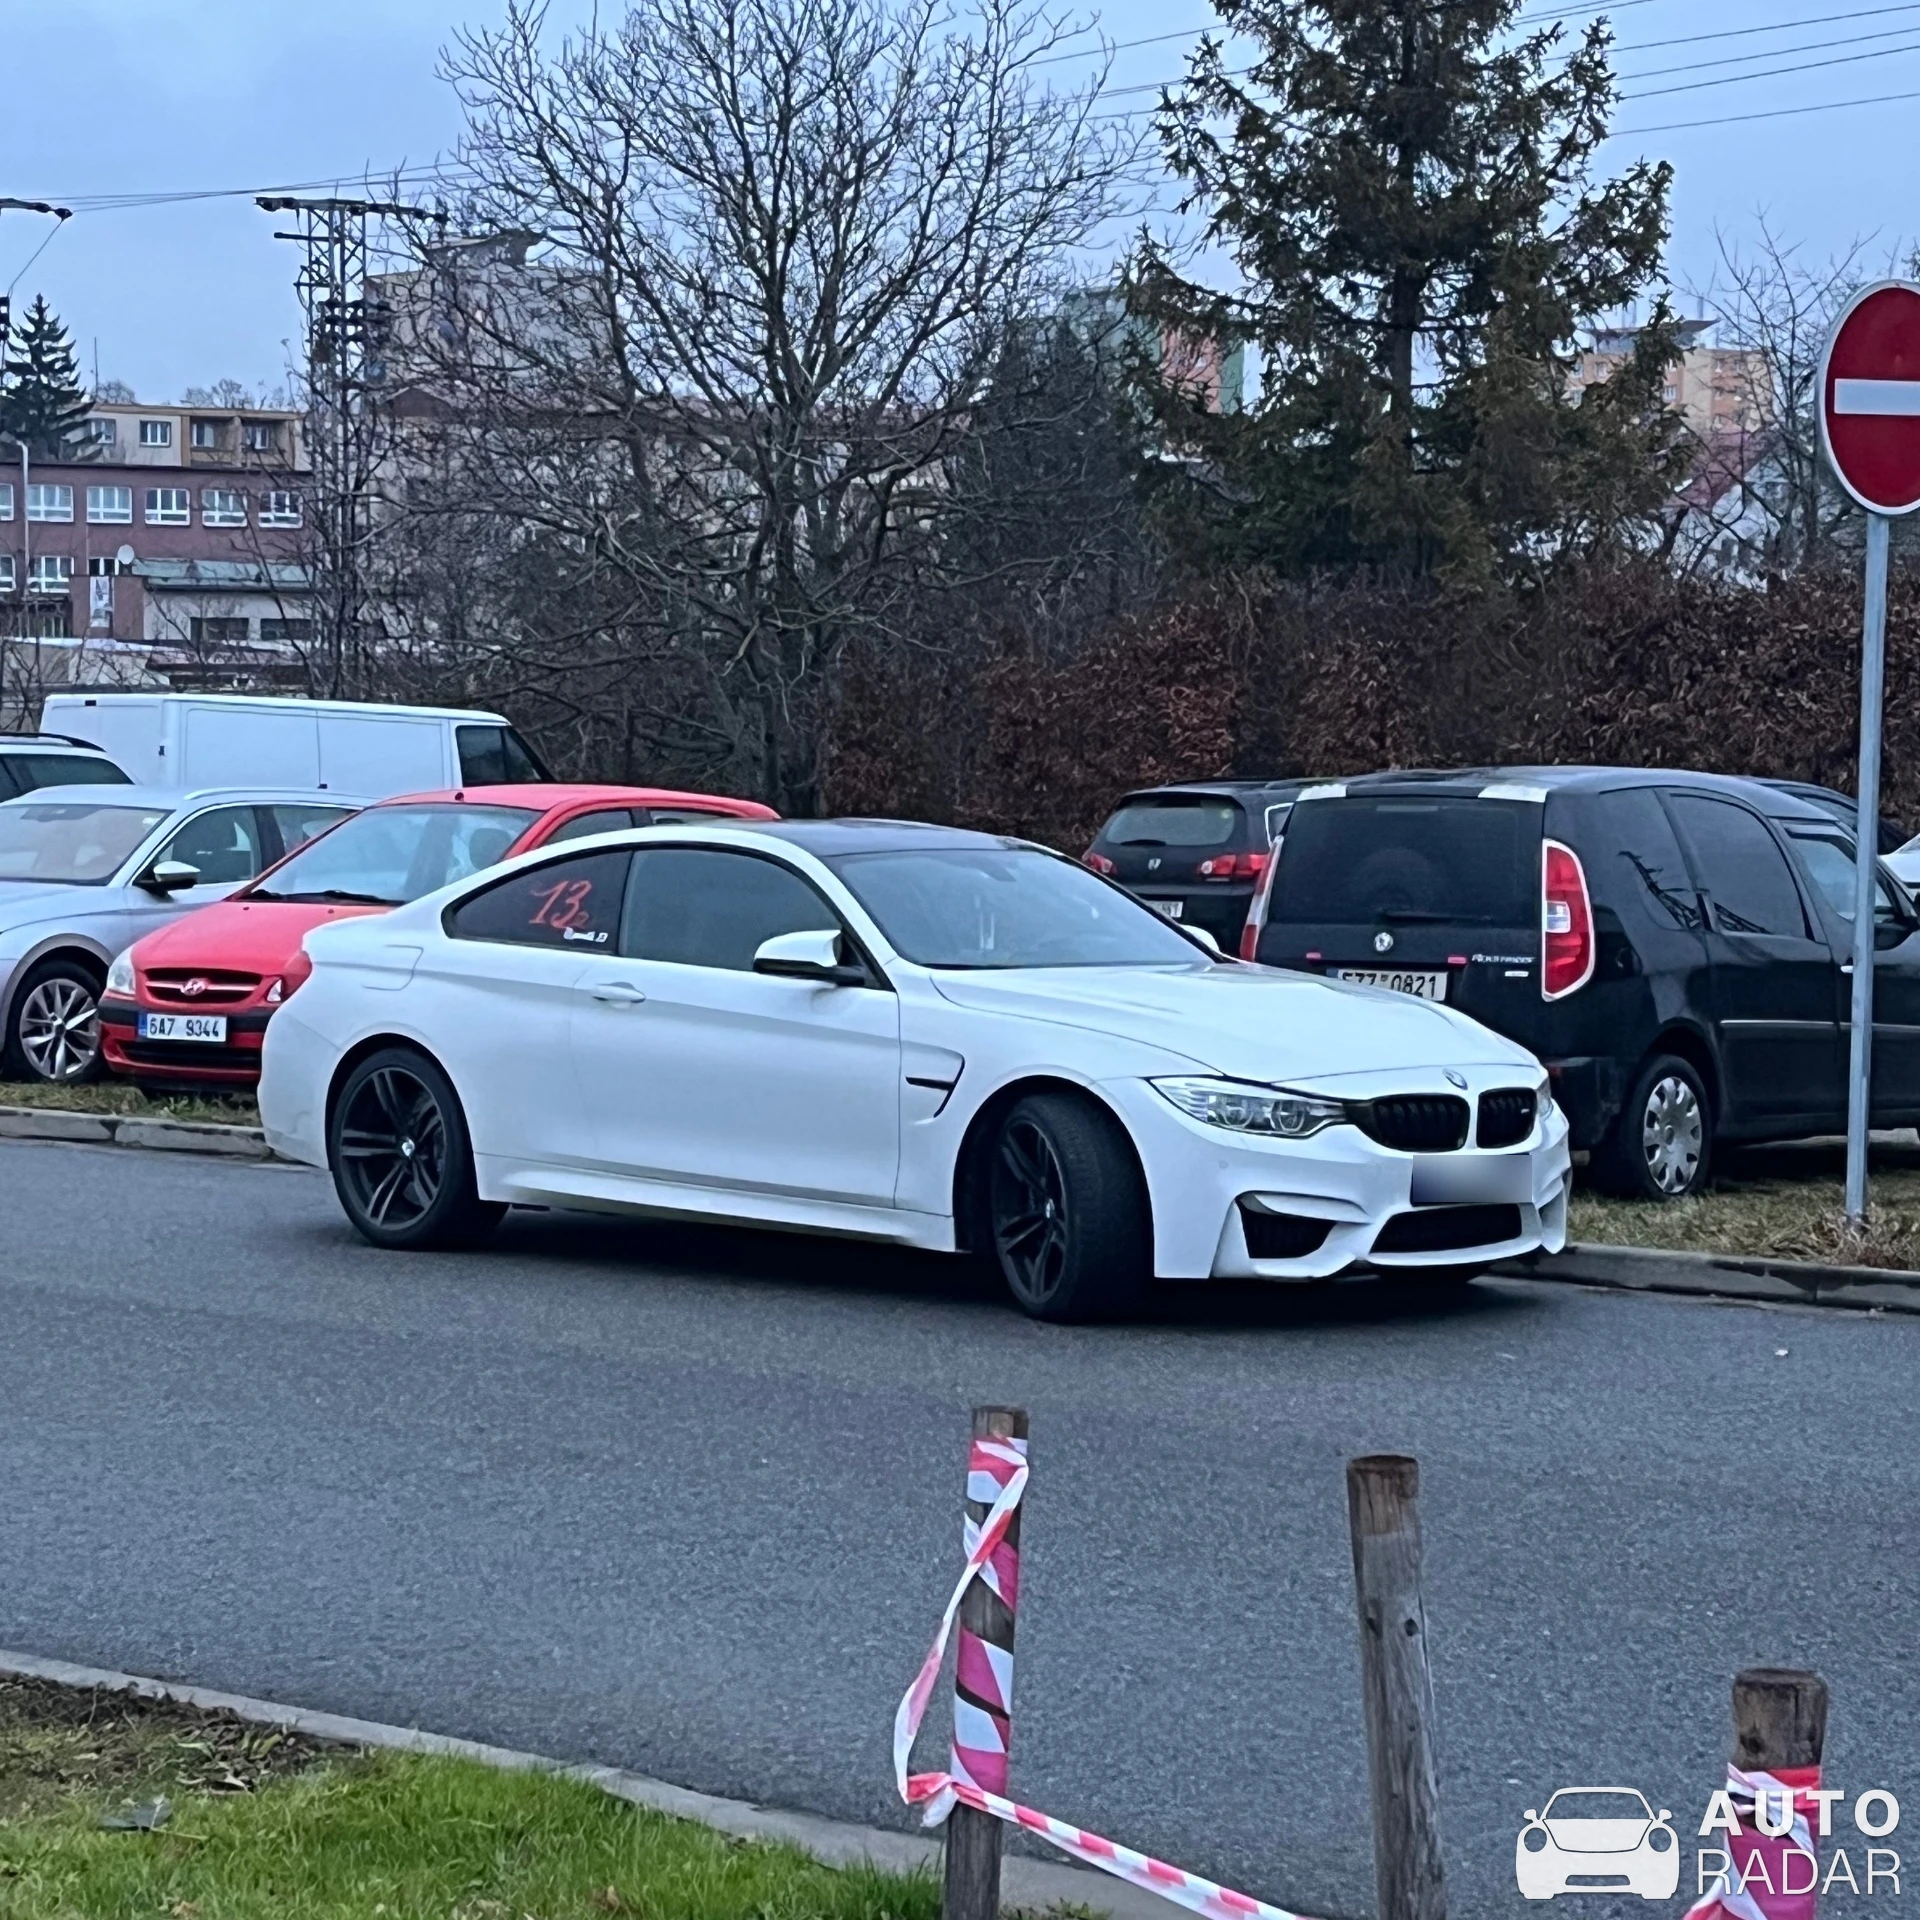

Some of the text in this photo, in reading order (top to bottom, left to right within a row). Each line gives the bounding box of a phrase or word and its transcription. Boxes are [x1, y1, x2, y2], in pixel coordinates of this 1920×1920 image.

[528, 880, 592, 929] 13
[1391, 974, 1436, 998] 0821
[149, 1017, 176, 1036] 6A7
